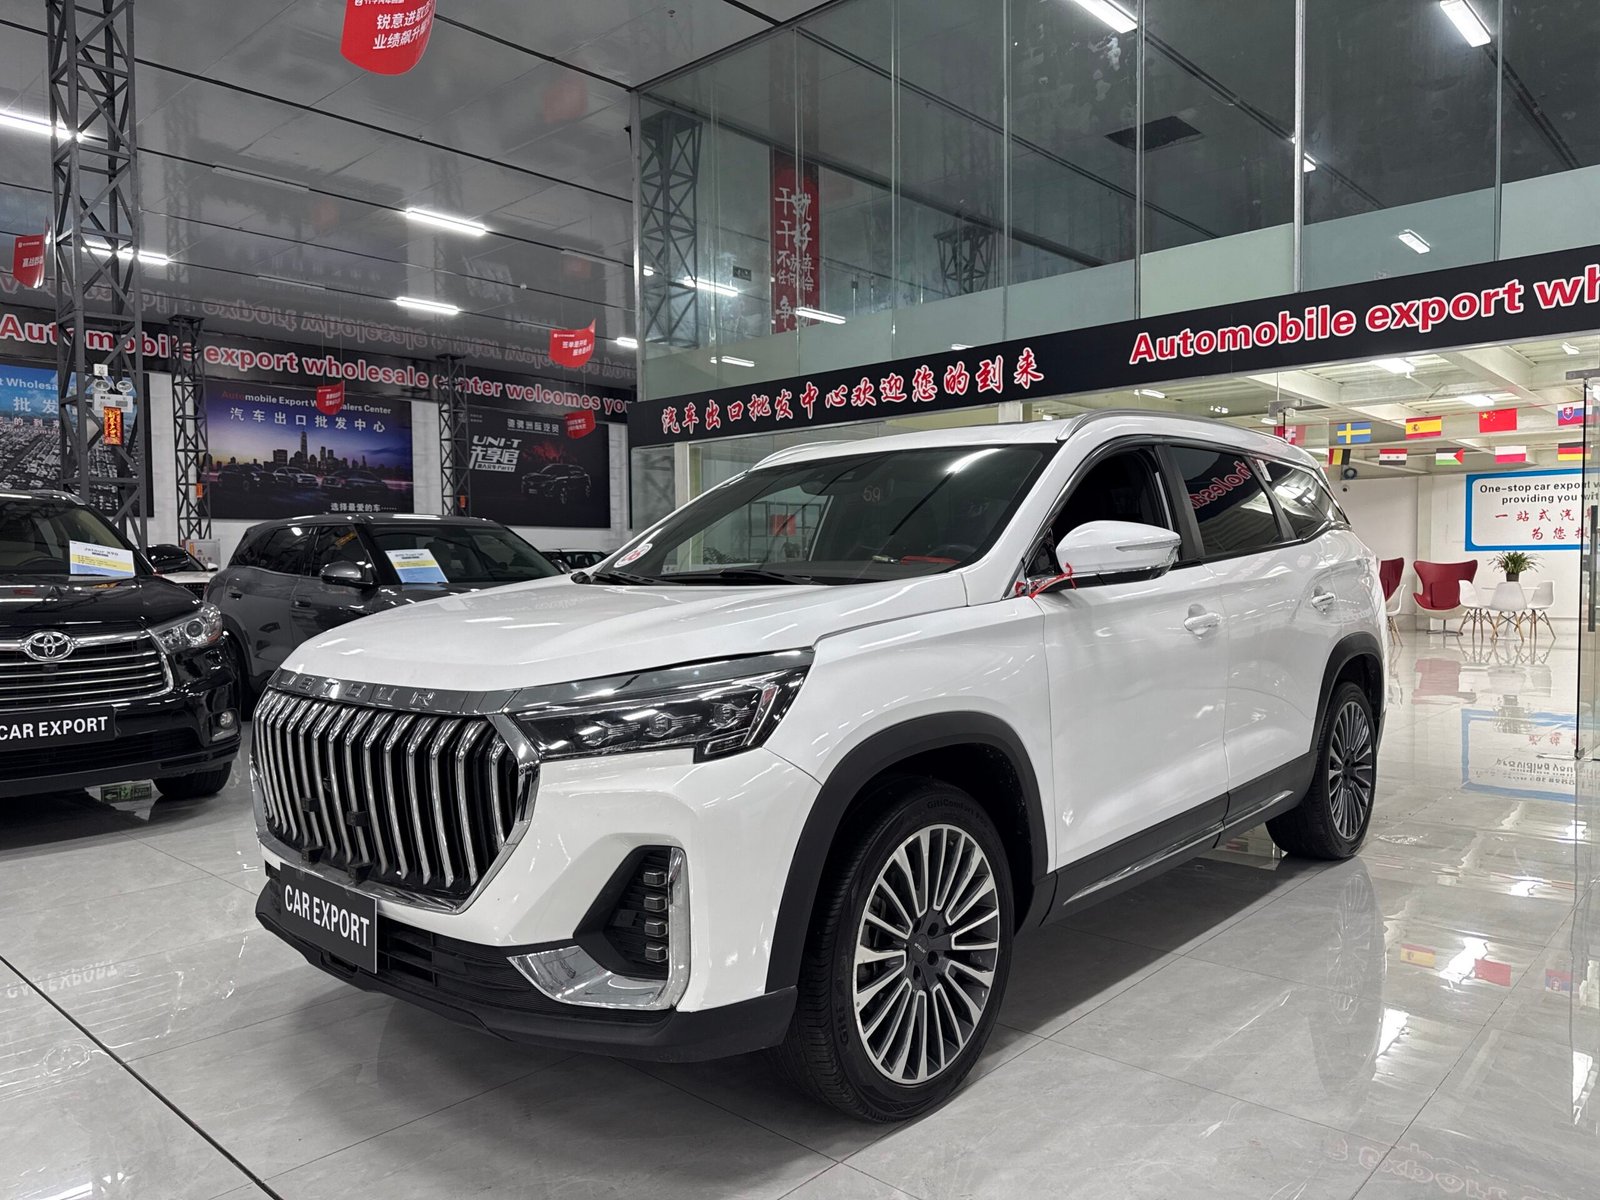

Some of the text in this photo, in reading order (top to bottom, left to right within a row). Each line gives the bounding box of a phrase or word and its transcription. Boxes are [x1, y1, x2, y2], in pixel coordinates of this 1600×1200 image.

[1129, 305, 1356, 365] Automobile
[1366, 280, 1524, 334] export
[204, 343, 298, 374] export
[303, 355, 429, 389] wholesale
[432, 373, 504, 399] cnter
[506, 382, 601, 411] welcomes
[222, 390, 277, 404] Automobile
[278, 396, 309, 409] Export
[310, 400, 362, 412] Walers
[364, 404, 392, 415] Center
[661, 346, 1045, 435] 汽车出口批发中心欢迎您的到来
[12, 396, 59, 415] 批发
[230, 407, 386, 433] 汽车出口批发中心
[472, 435, 522, 448] UNI-T
[1480, 483, 1532, 494] One-stop
[1534, 483, 1551, 491] car
[1554, 481, 1590, 491] expot
[1502, 493, 1554, 505] providing
[1557, 494, 1578, 504] you
[0, 716, 108, 741] CAR EXPORT
[284, 884, 370, 948] CAR EXPORT
